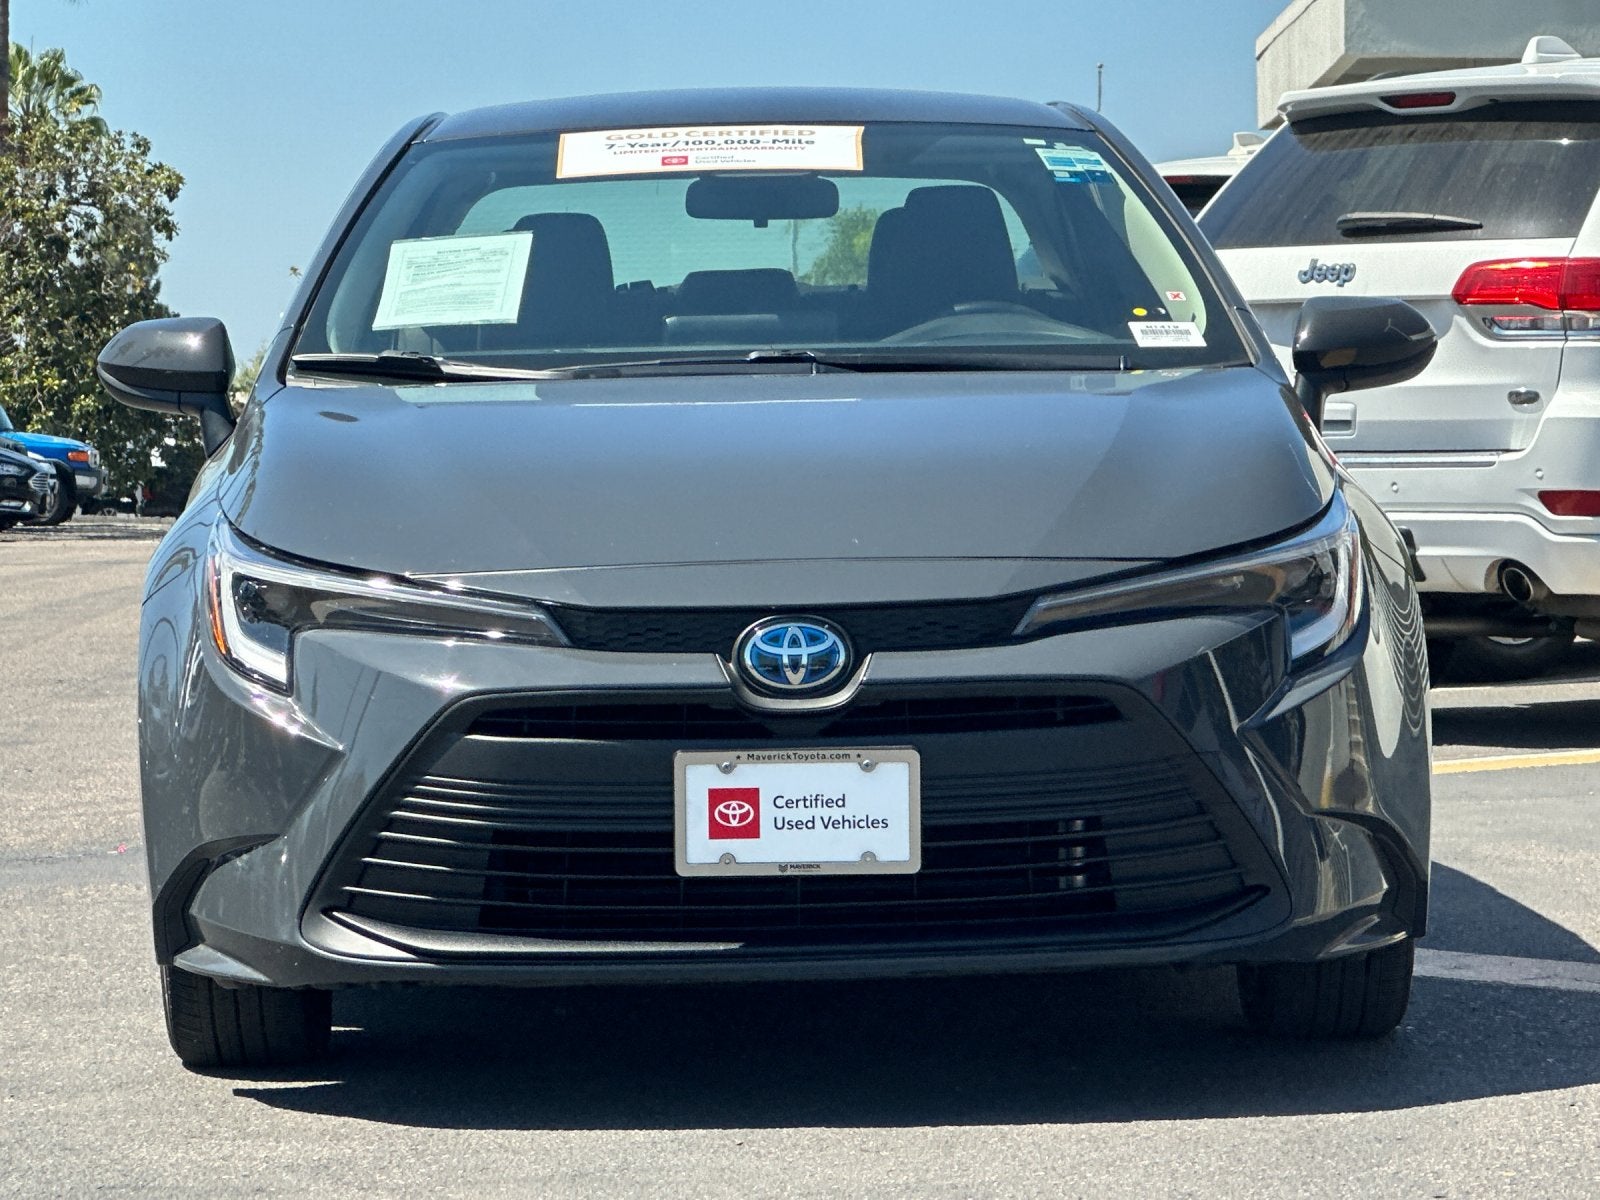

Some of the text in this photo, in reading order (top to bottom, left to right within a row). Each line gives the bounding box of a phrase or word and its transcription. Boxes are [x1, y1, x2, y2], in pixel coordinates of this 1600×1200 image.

[605, 129, 816, 140] GOLD CERTIFIED
[605, 138, 816, 150] 7-Year/100,000-Mile
[1298, 258, 1356, 287] Jeep
[747, 752, 851, 761] MaverickToyota.com
[773, 793, 846, 809] Certified
[773, 815, 889, 830] Used Vehicles
